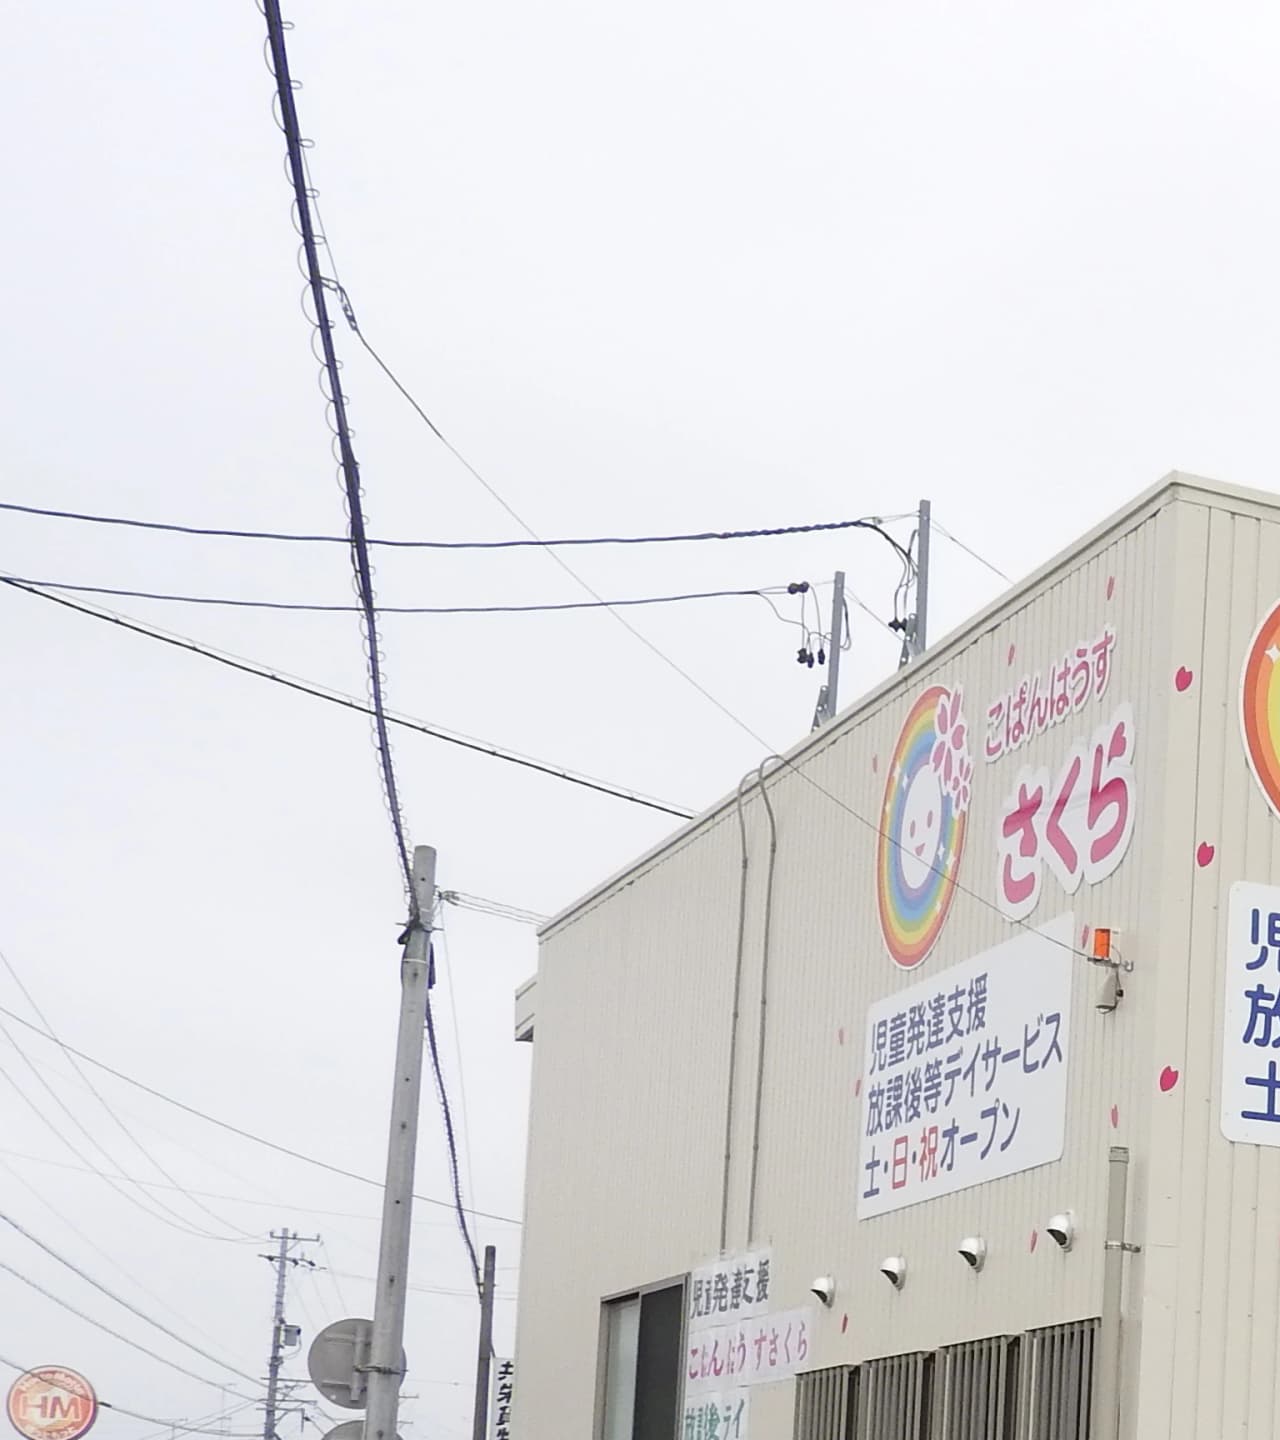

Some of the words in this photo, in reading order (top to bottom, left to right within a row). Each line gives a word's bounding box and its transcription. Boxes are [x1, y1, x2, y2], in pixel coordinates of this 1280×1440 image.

[986, 631, 1114, 756] こぱんはうす
[1003, 721, 1129, 904] さくら
[866, 1012, 1063, 1137] 放課後等デイサービス
[869, 972, 989, 1075] 児童発達支援
[863, 1098, 1021, 1199] 土・日・祝オープン
